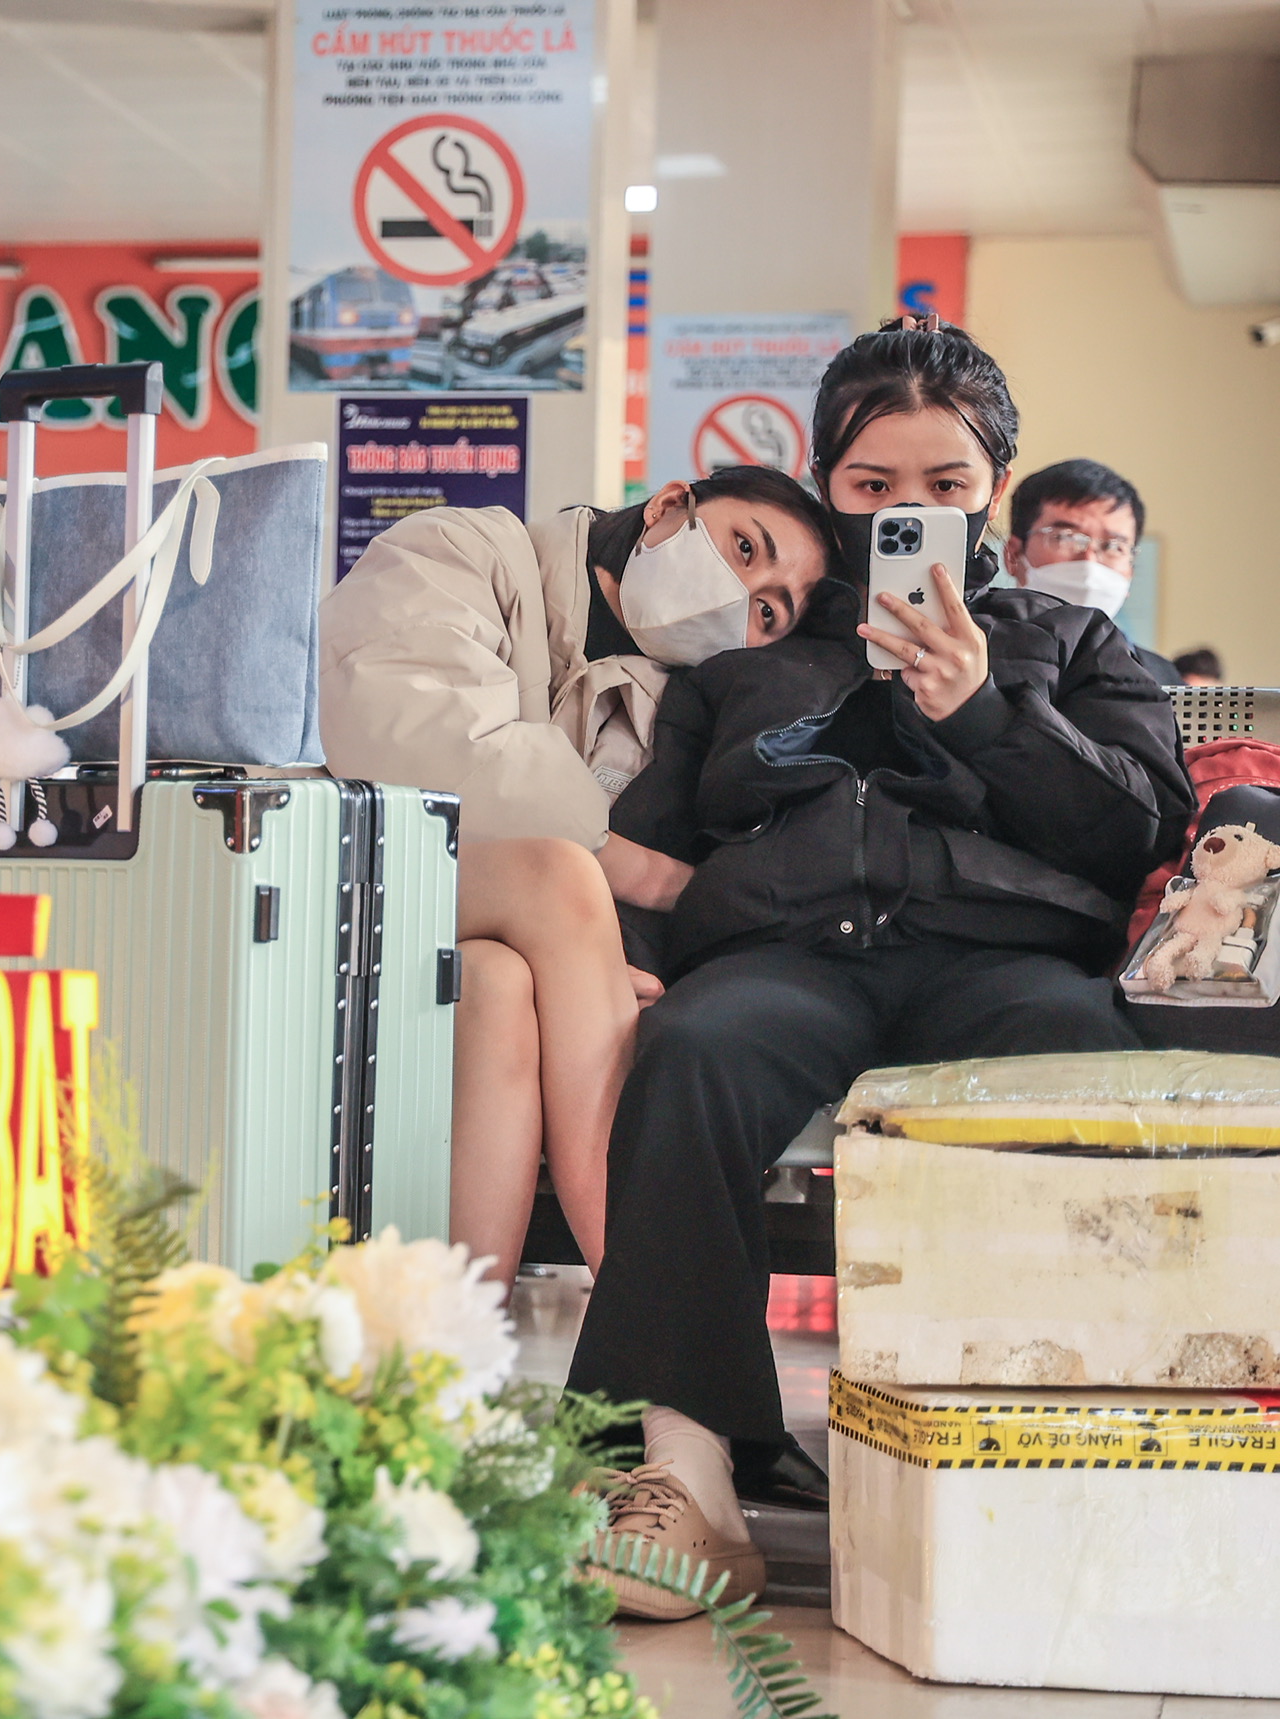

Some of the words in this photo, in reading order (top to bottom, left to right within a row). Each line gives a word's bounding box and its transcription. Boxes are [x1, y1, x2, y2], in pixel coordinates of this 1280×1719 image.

[311, 21, 371, 56] CẤM
[378, 24, 434, 54] HÚT
[442, 19, 535, 53] THUỐC
[544, 19, 578, 52] LÁ
[346, 441, 396, 473] THÔNG
[398, 440, 428, 473] BÁO
[429, 436, 476, 473] TUYỂN
[477, 445, 520, 478] DỤNG
[1075, 1432, 1123, 1450] HÀNG
[1188, 1434, 1276, 1450] FRAGILE
